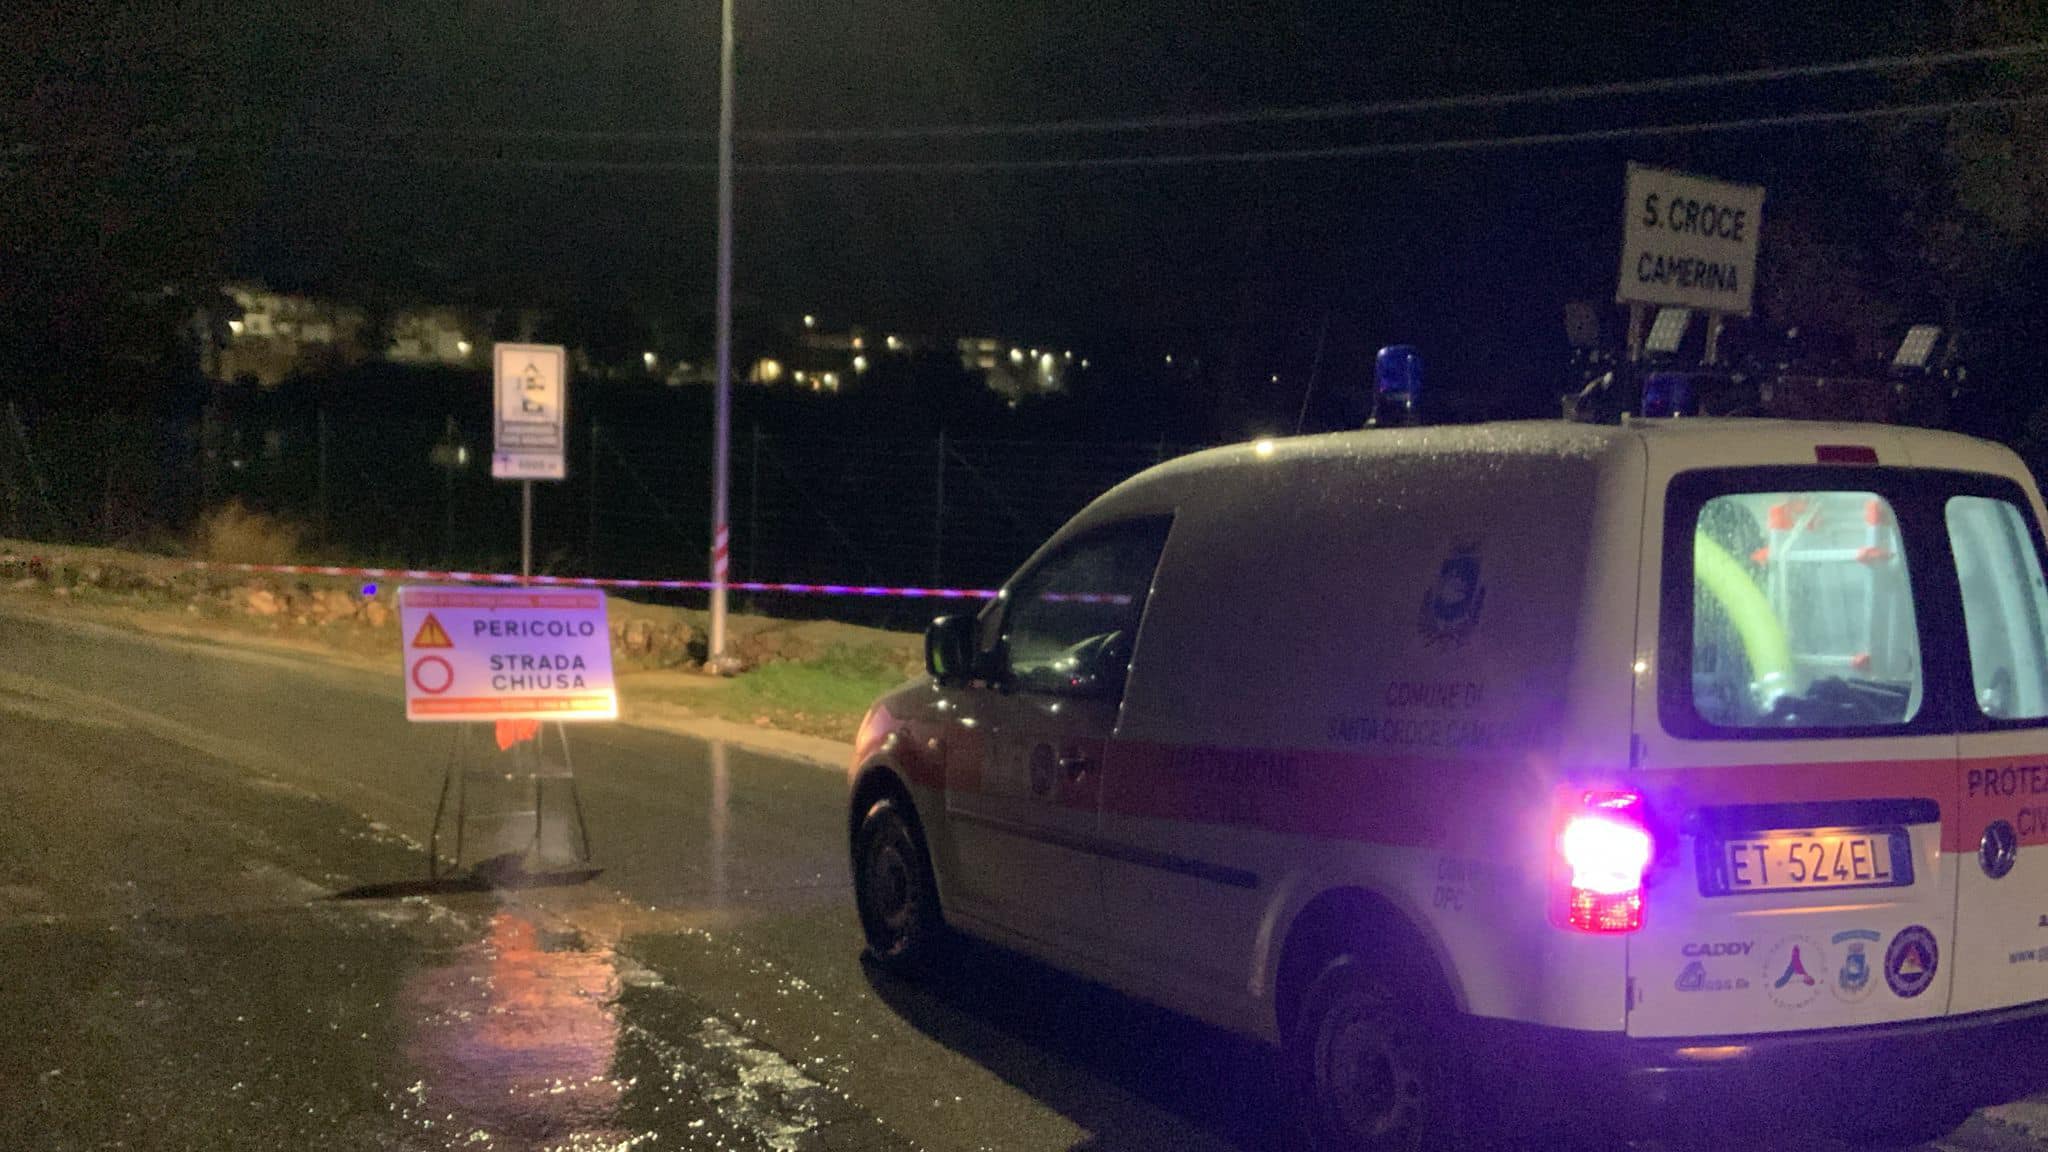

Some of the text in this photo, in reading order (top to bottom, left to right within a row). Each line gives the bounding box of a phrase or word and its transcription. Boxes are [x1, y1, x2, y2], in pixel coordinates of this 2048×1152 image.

[1669, 197, 1746, 242] CROCE
[1637, 252, 1738, 293] CAMERINA
[473, 619, 595, 637] PERICOLO
[490, 654, 587, 671] STRADA
[492, 674, 586, 690] CHIUSA
[1731, 839, 1889, 885] ET 524EL
[1681, 941, 1754, 957] CADDY
